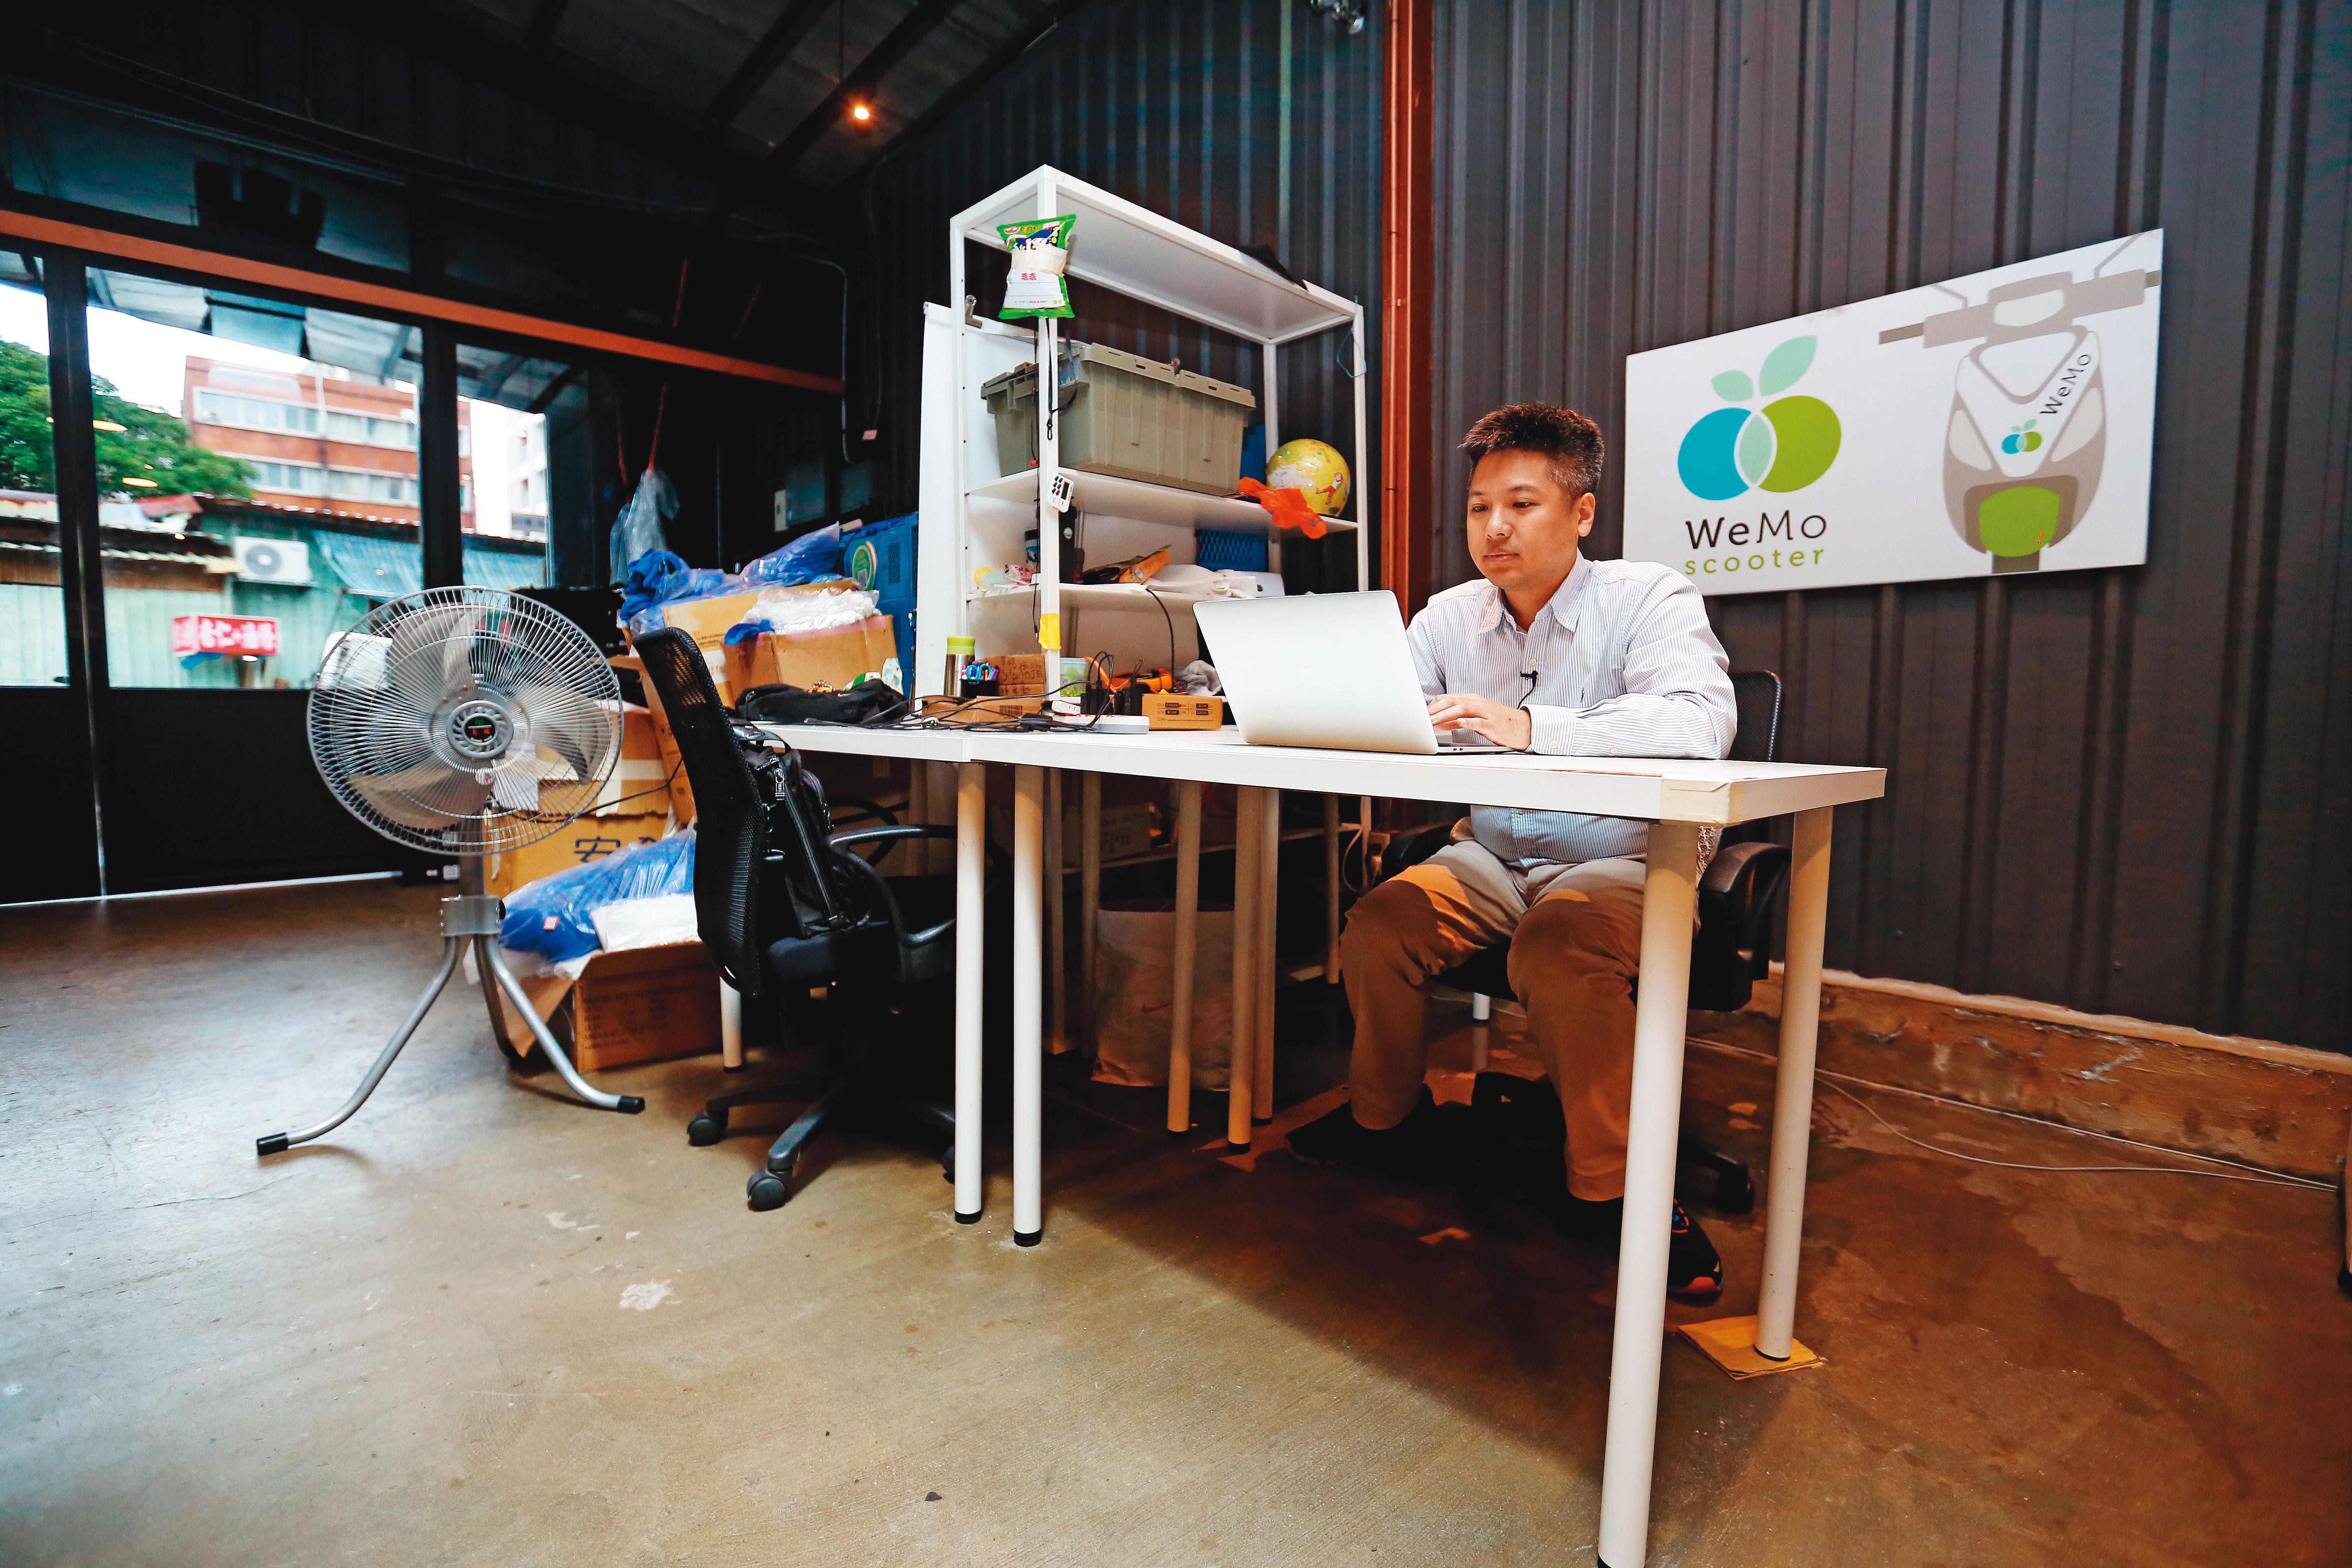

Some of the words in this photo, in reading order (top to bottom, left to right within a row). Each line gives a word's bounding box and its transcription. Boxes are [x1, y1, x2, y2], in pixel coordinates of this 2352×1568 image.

[1021, 272, 1036, 281] 乖乖
[2039, 354, 2091, 414] WeMo
[1685, 509, 1827, 550] WeMo
[1685, 549, 1824, 575] scooter
